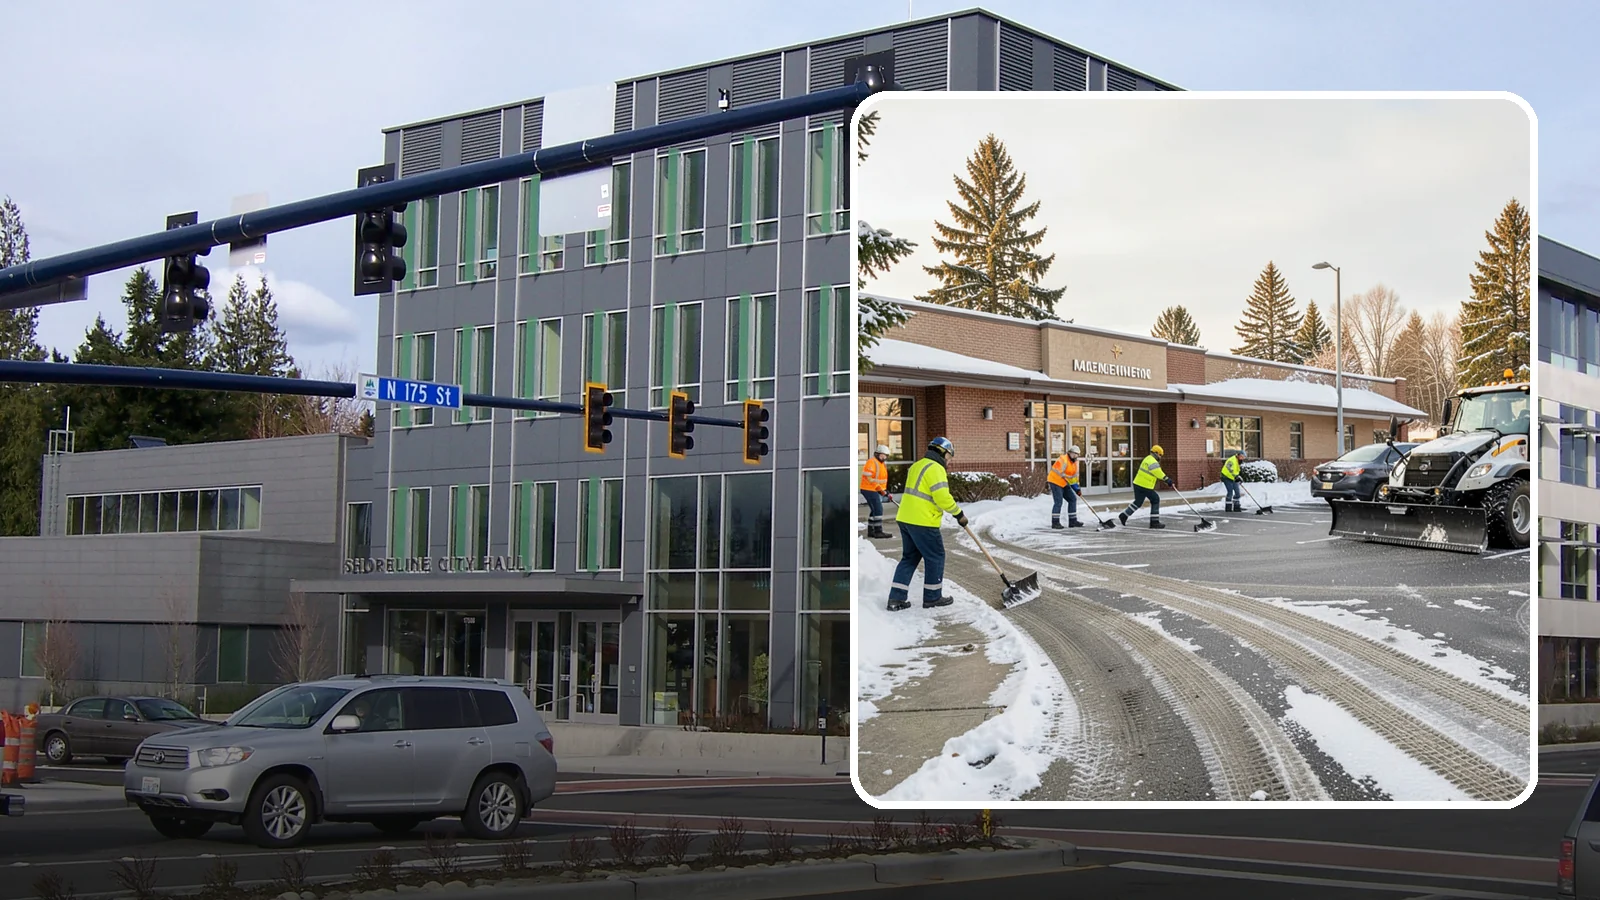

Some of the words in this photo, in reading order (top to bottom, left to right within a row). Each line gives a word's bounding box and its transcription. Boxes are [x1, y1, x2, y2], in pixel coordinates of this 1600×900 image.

[387, 380, 396, 399] N
[405, 383, 427, 403] 175
[436, 387, 451, 406] St
[344, 557, 432, 574] SHORELINE
[439, 556, 475, 573] CITY
[483, 555, 525, 572] HALL
